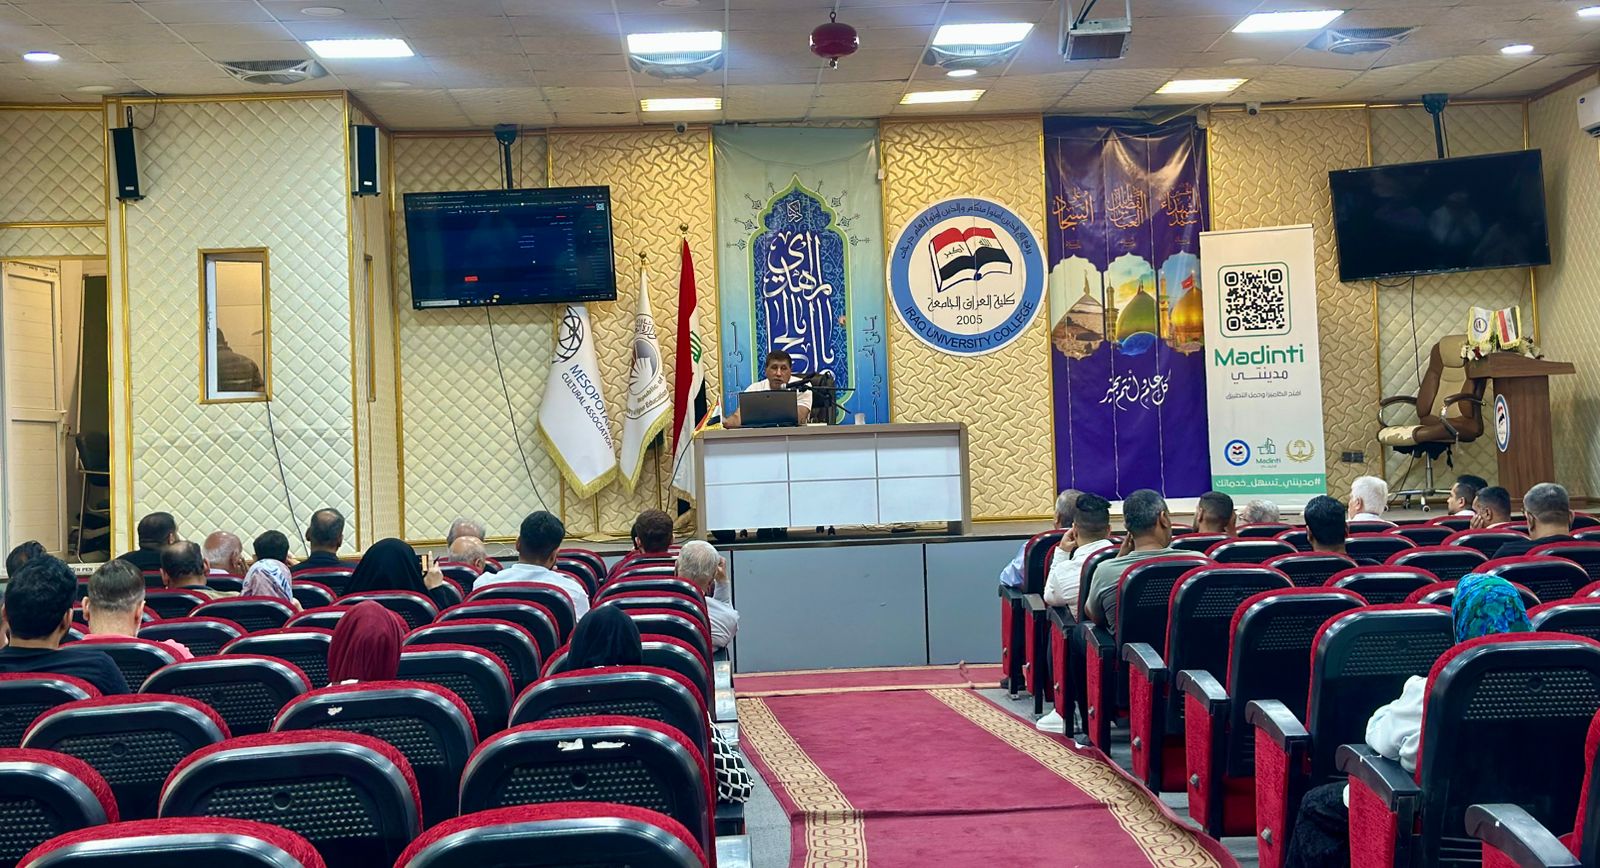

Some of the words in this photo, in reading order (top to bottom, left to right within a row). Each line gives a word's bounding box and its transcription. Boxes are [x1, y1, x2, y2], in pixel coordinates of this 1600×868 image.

[927, 296, 961, 312] الجامعة
[962, 294, 992, 310] العراق
[993, 292, 1016, 310] كلية
[904, 306, 927, 332] IRAQ
[927, 329, 992, 349] UNIVERSITY
[993, 300, 1035, 341] COLLEGE
[956, 314, 983, 325] 2005
[1214, 343, 1304, 367] Madinti
[1231, 366, 1288, 385] مدينتي
[561, 372, 586, 406] CULTURAL
